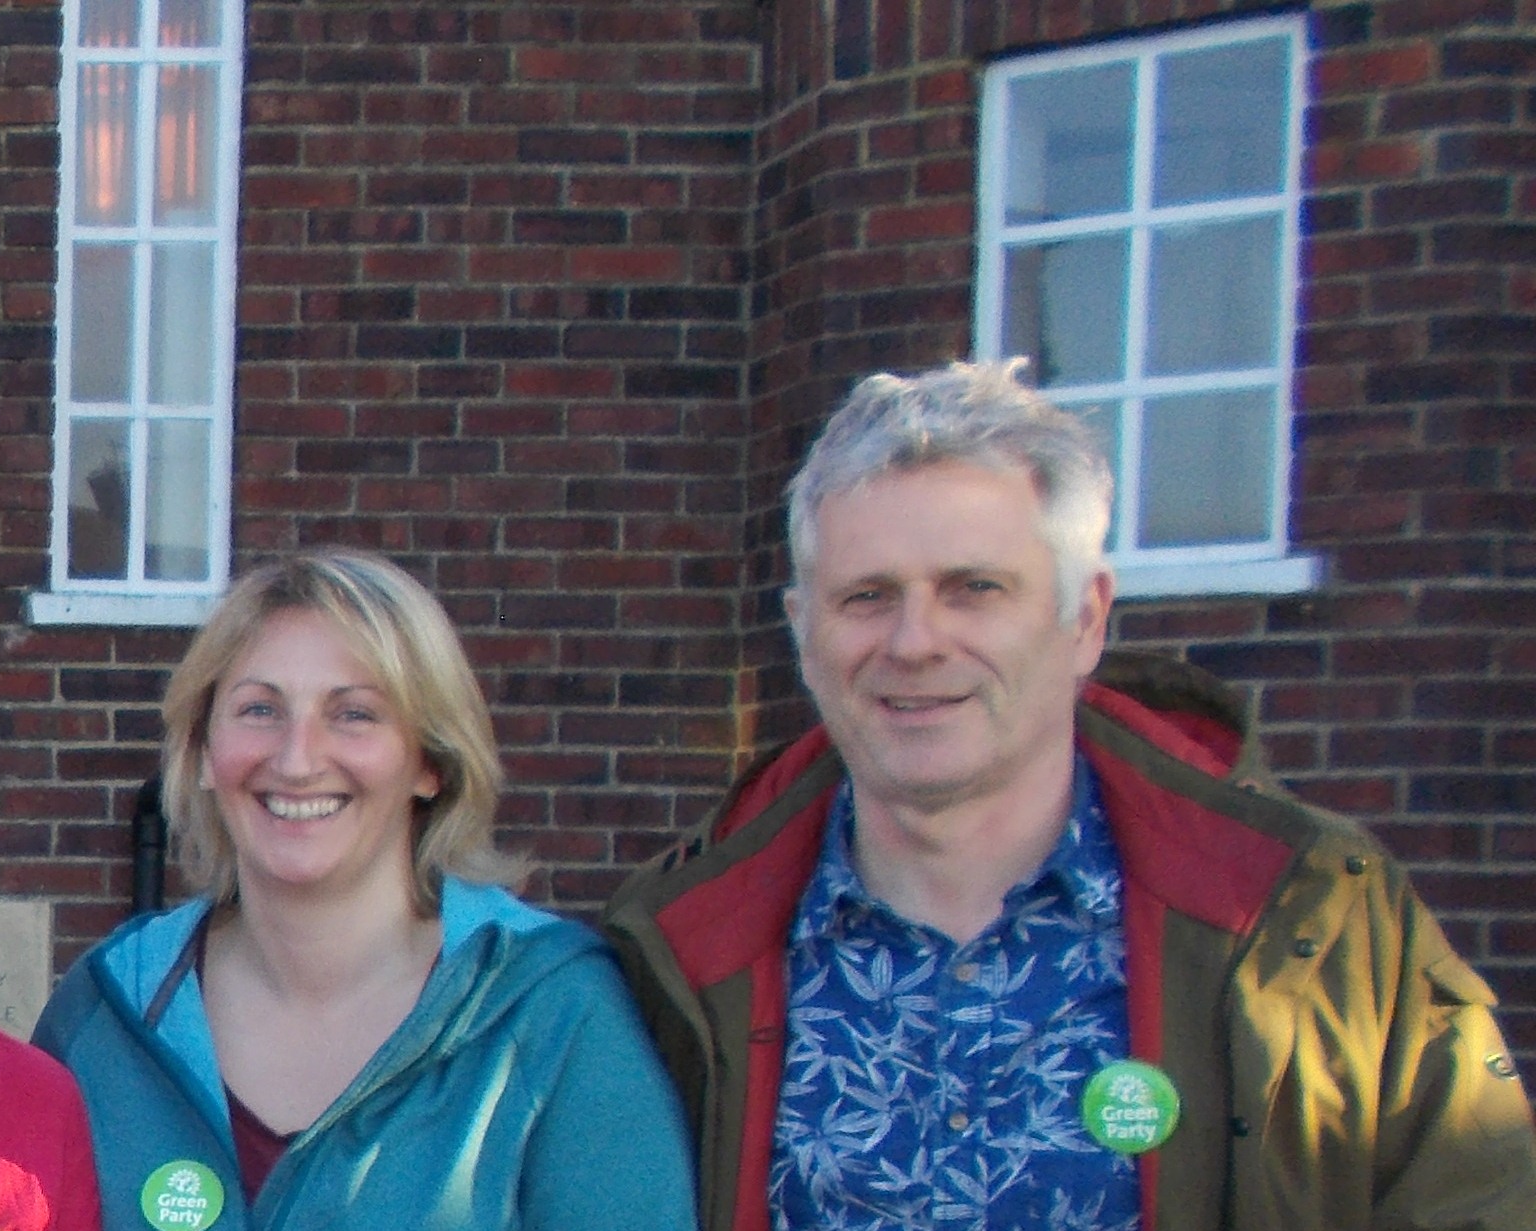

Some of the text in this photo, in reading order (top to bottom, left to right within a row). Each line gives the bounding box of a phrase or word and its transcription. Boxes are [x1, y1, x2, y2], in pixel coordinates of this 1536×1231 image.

[1101, 1105, 1159, 1121] Green
[1107, 1123, 1157, 1143] Party
[158, 1193, 208, 1209] Green
[160, 1208, 203, 1227] Party
